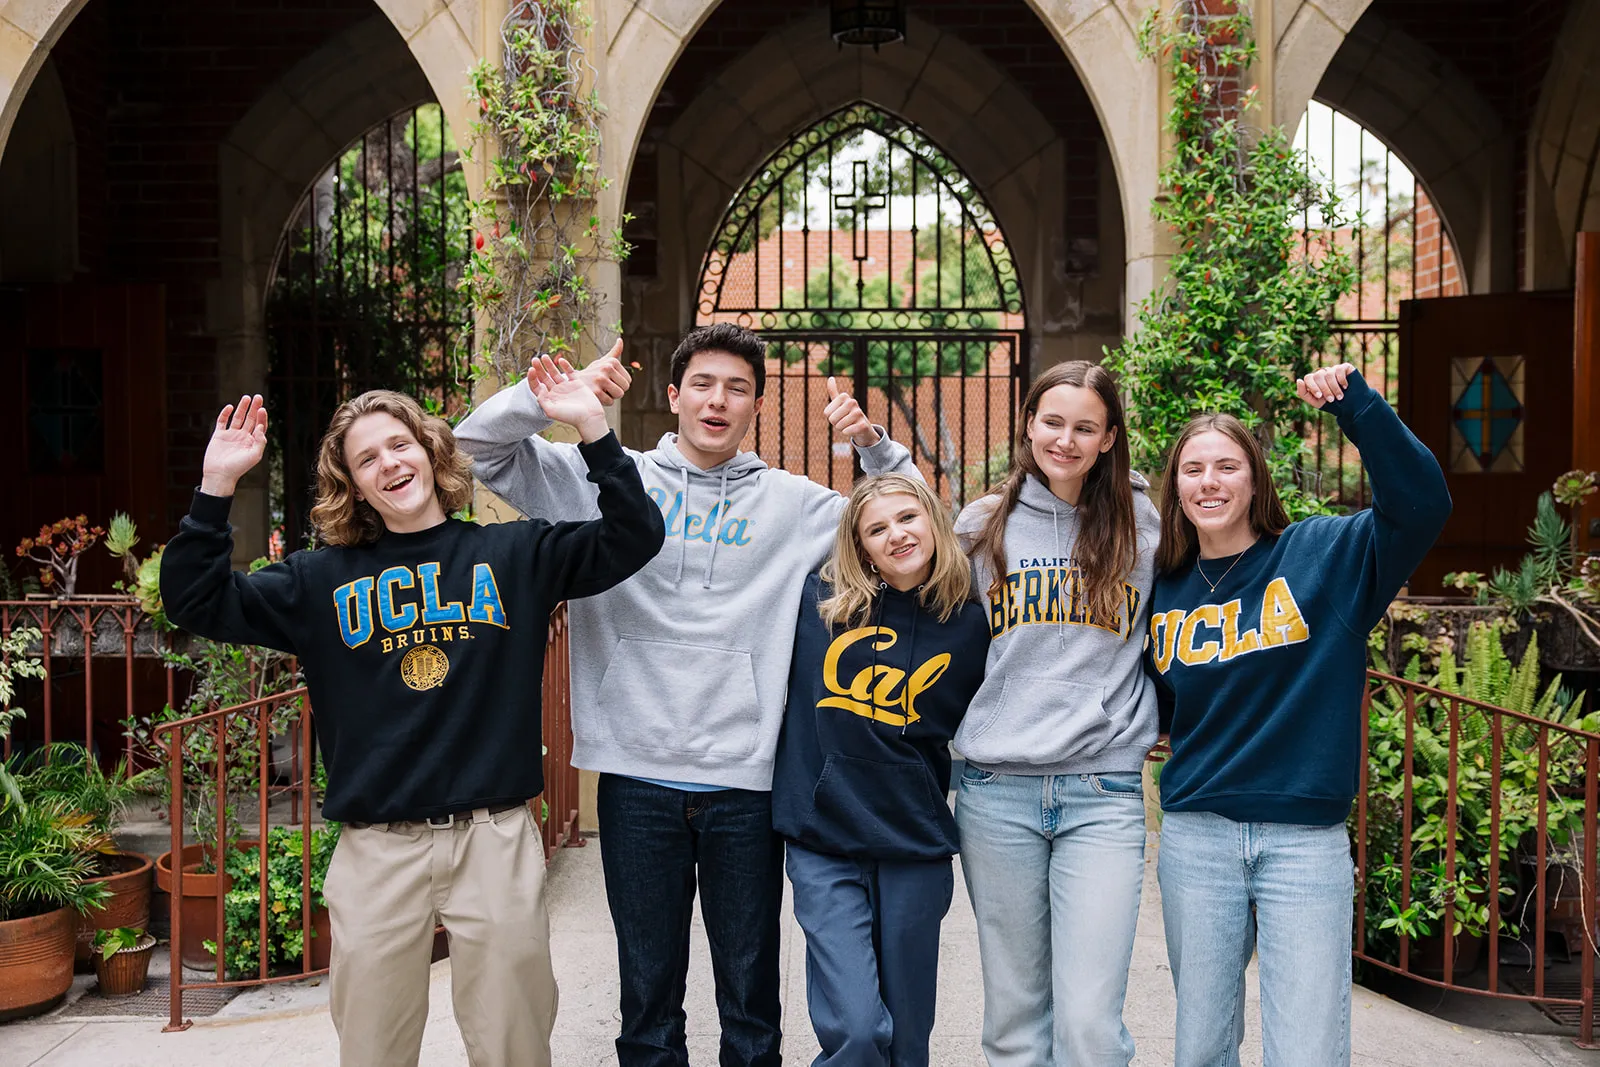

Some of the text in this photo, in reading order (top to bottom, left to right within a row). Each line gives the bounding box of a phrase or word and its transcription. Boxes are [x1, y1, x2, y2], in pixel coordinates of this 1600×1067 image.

[333, 561, 509, 650] UCLA
[380, 625, 470, 654] BRUINS
[1150, 576, 1310, 676] UCLA
[815, 625, 952, 727] Cal
